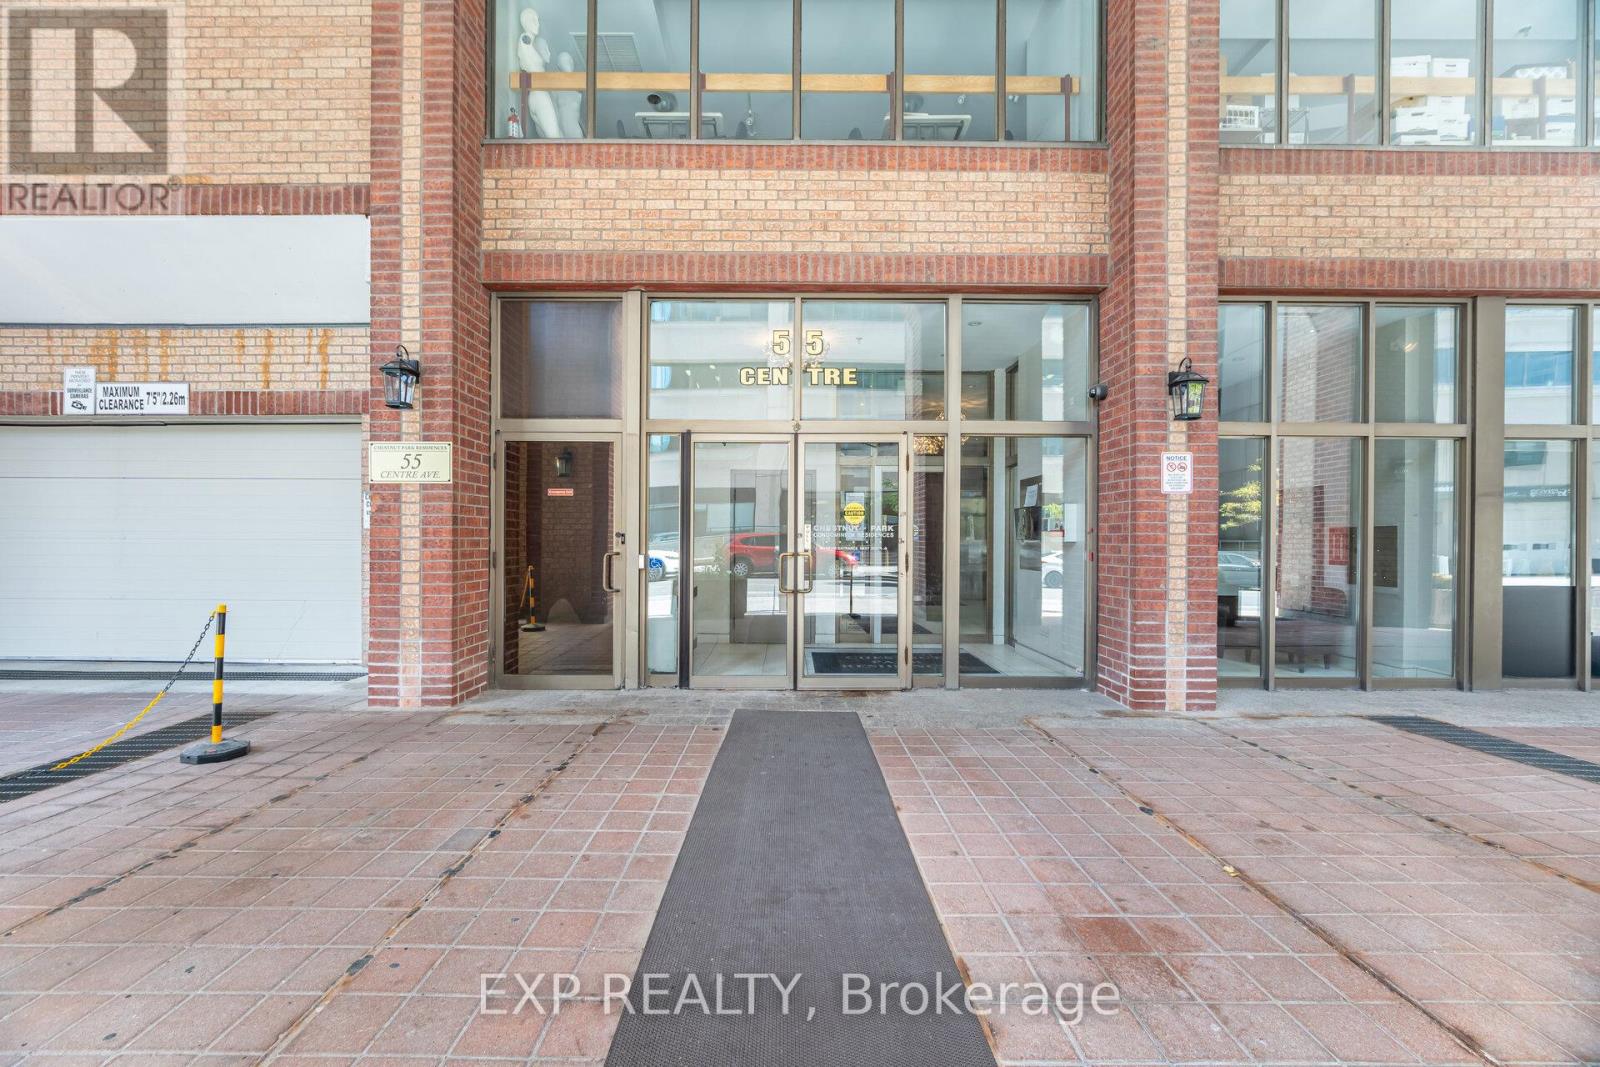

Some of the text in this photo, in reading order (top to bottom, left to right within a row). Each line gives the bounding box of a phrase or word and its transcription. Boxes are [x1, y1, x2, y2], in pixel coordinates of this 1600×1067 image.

[739, 366, 858, 386] CENTRE
[102, 386, 140, 398] MAXIMUM
[98, 399, 144, 410] CLEARANCE
[400, 453, 422, 470] 55
[380, 470, 419, 479] CENTRE
